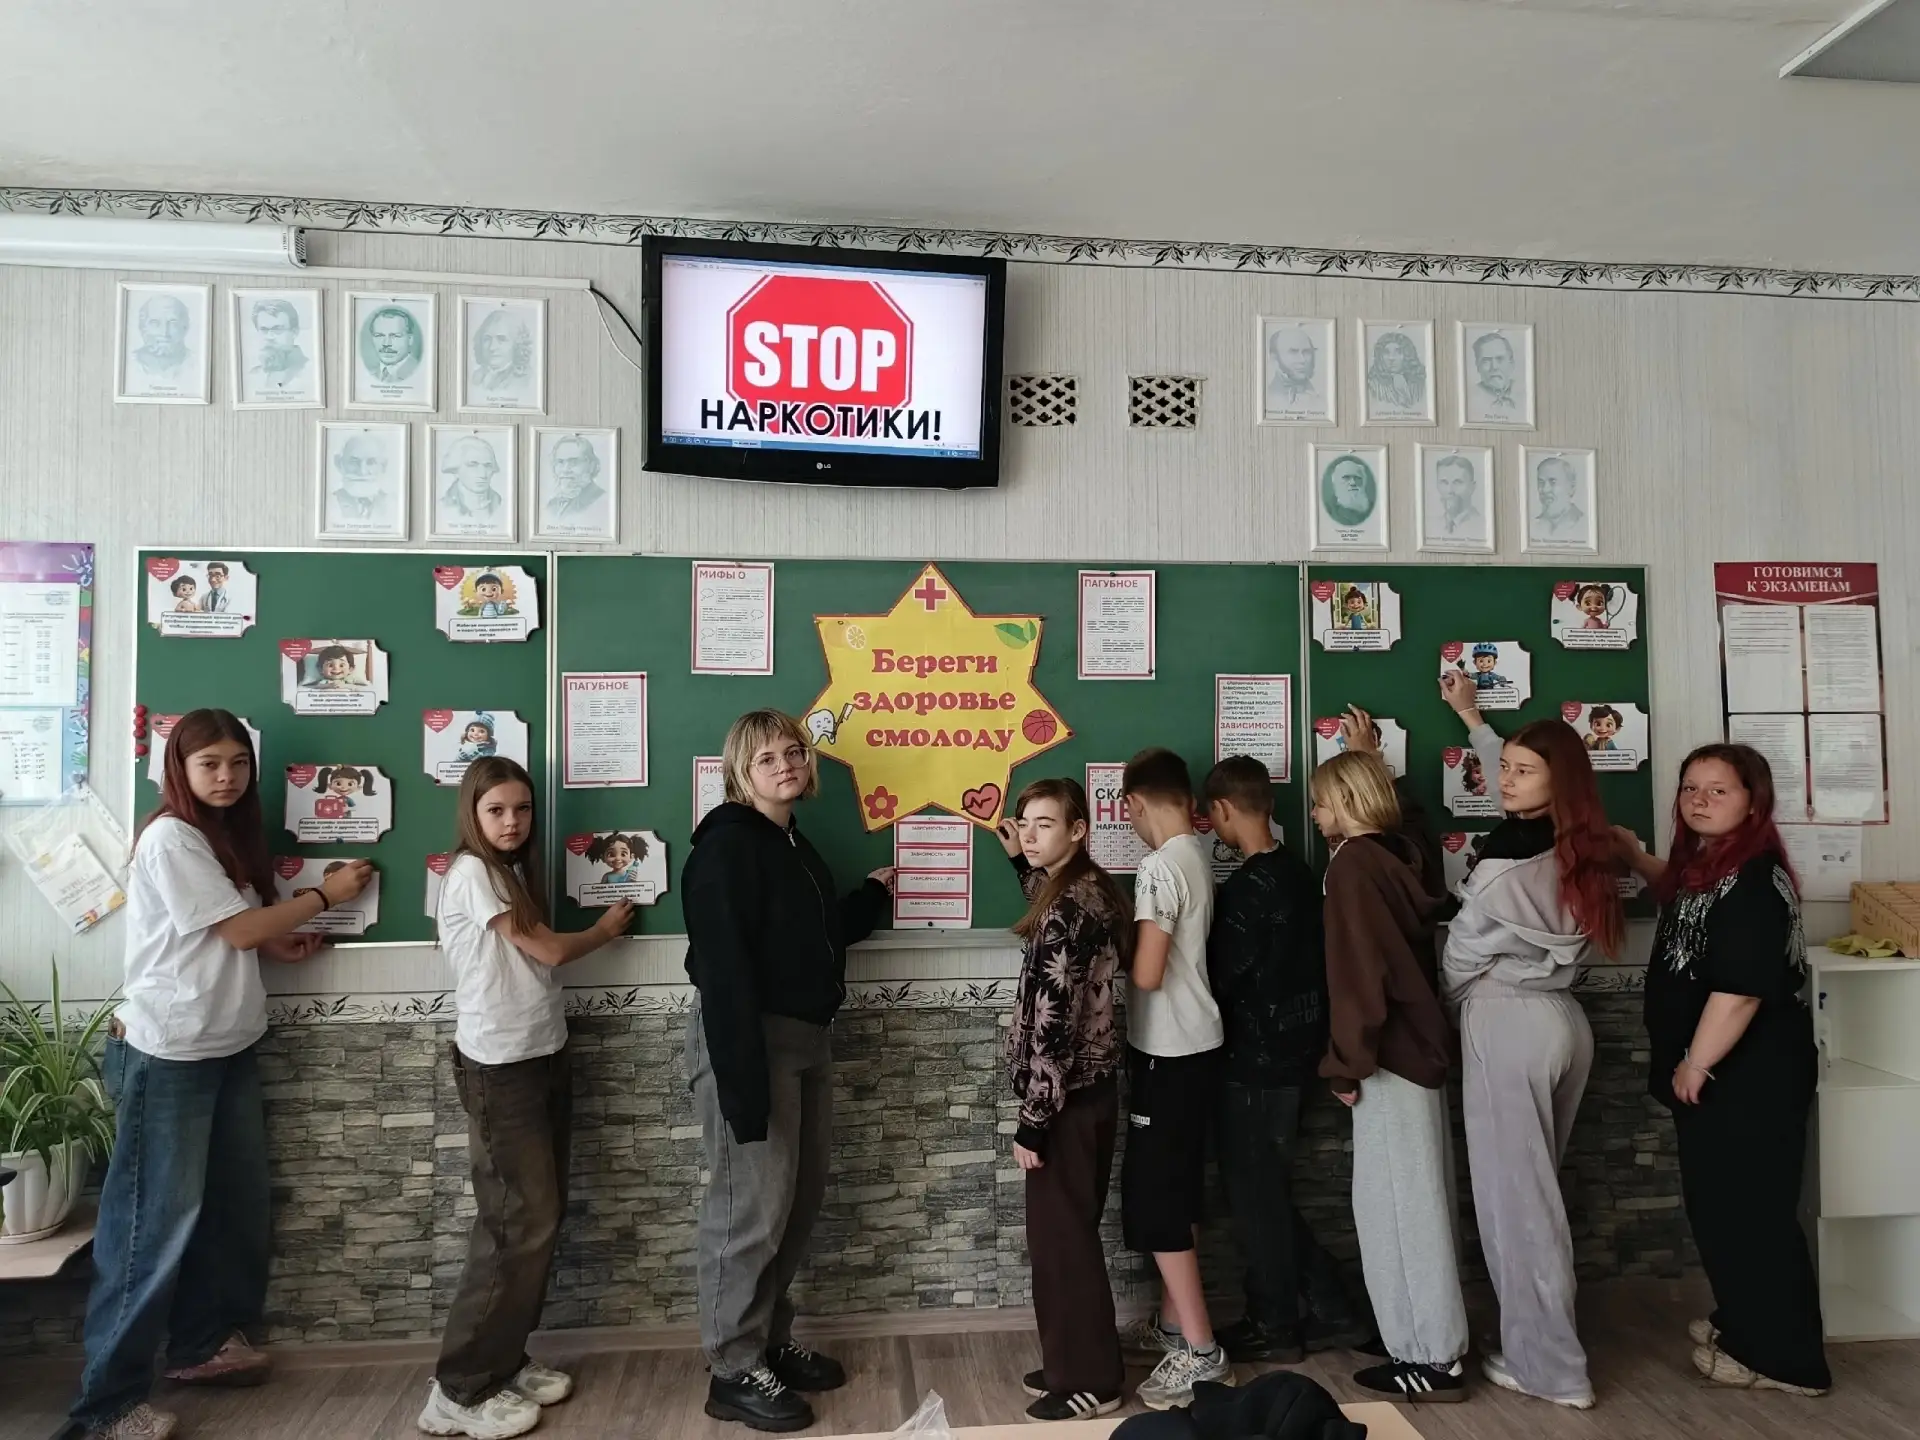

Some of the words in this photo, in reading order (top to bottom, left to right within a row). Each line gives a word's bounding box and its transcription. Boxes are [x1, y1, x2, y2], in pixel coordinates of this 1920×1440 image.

[743, 321, 896, 392] STOP
[701, 398, 941, 440] НАРКОТИКИ!
[700, 570, 735, 579] МИФЫ
[738, 571, 746, 579] О
[1754, 566, 1843, 578] ГОТОВИМСЯ
[1084, 579, 1138, 588] ПАГУБНОЕ
[1747, 581, 1757, 592] К
[1760, 580, 1850, 593] ЭКЗАМЕНАМ
[871, 649, 998, 678] Береги
[569, 682, 629, 691] ПАГУБНОЕ
[853, 692, 1016, 715] здоровье
[866, 728, 1015, 751] смолоду
[1096, 788, 1122, 800] СКА
[1096, 800, 1131, 822] НЕ
[1096, 823, 1133, 831] НАРКОТ
